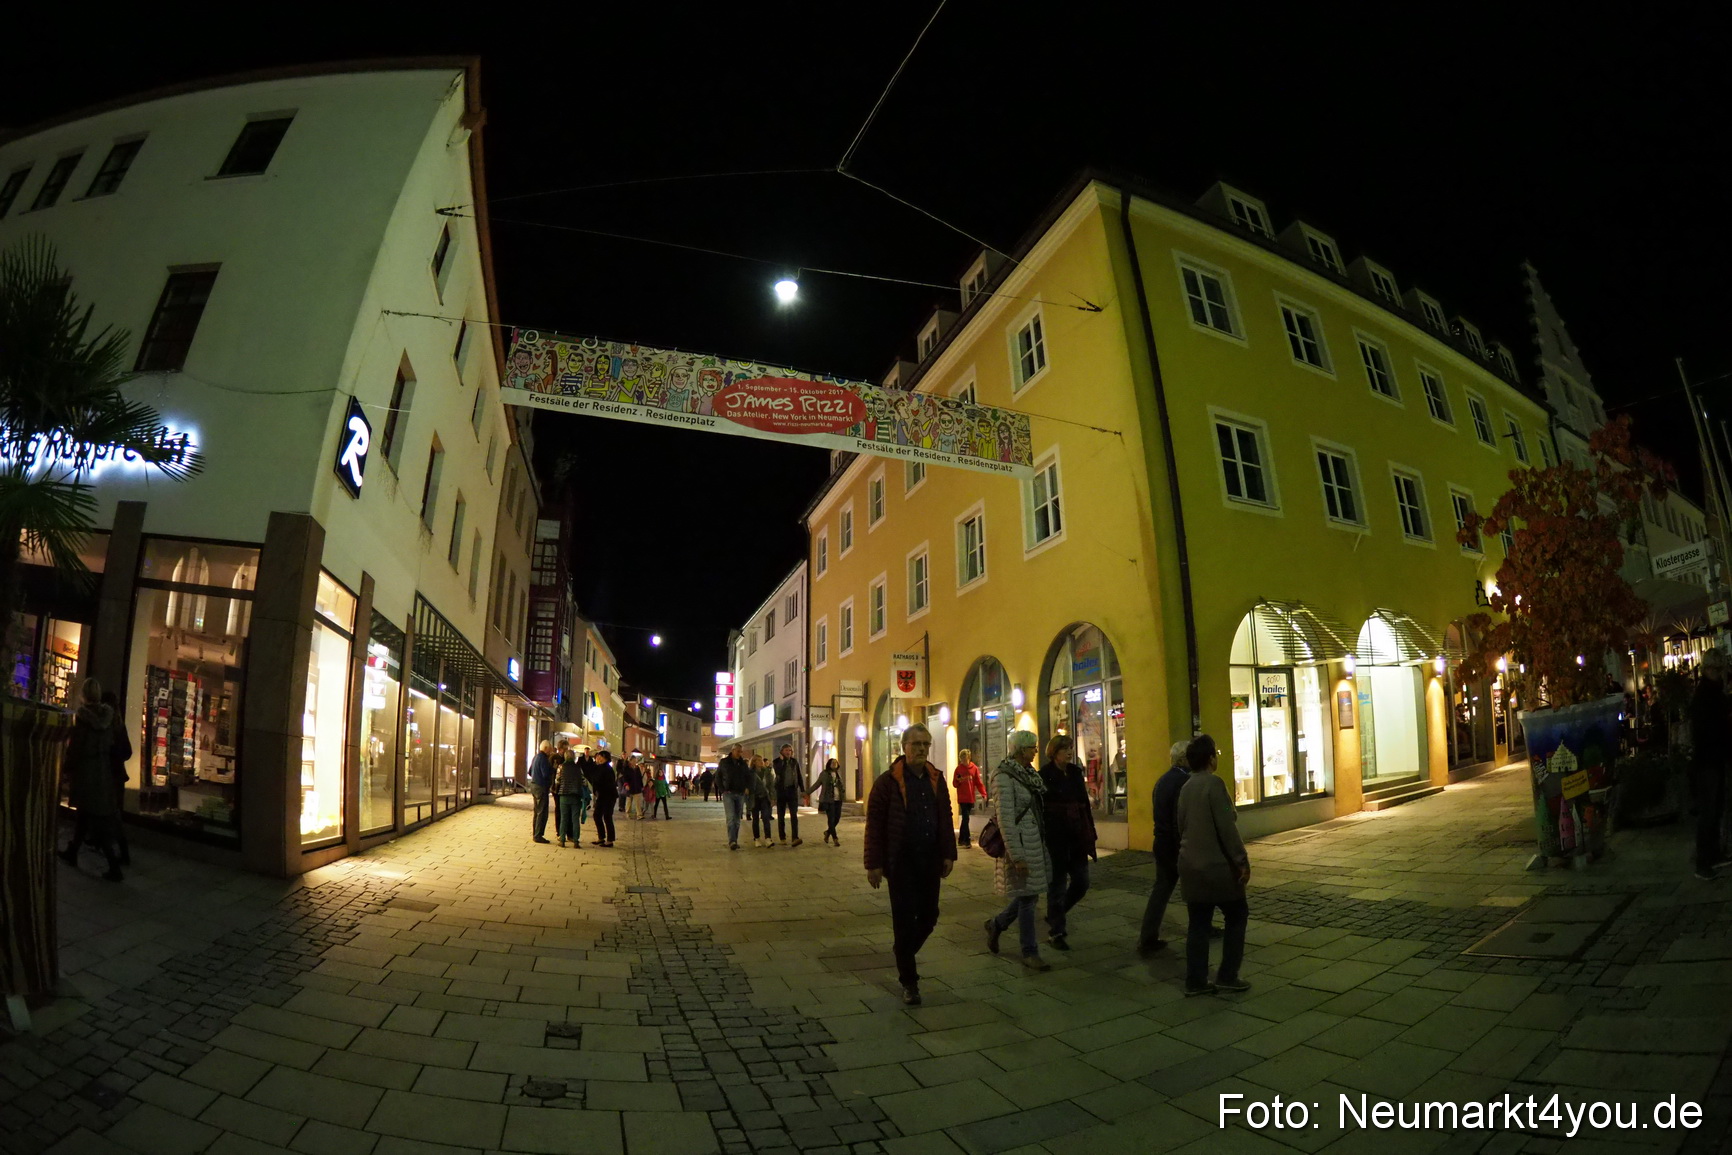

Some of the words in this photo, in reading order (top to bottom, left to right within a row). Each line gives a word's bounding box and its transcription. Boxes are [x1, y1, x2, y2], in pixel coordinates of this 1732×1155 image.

[745, 384, 782, 393] September
[528, 393, 570, 407] Festsäle
[572, 399, 590, 409] der
[592, 401, 638, 416] Residenz
[645, 408, 715, 427] Residenzplatz
[799, 395, 852, 415] RIZZI
[726, 410, 741, 418] Das
[772, 412, 789, 420] New
[789, 413, 807, 421] York
[817, 413, 854, 423] Neumarkt
[856, 440, 894, 454] Festsäle
[895, 447, 911, 456] der
[913, 448, 951, 463] Residenz
[957, 456, 1013, 473] Residenzplatz
[1656, 548, 1700, 569] Klostergasse
[1262, 685, 1286, 693] hailer
